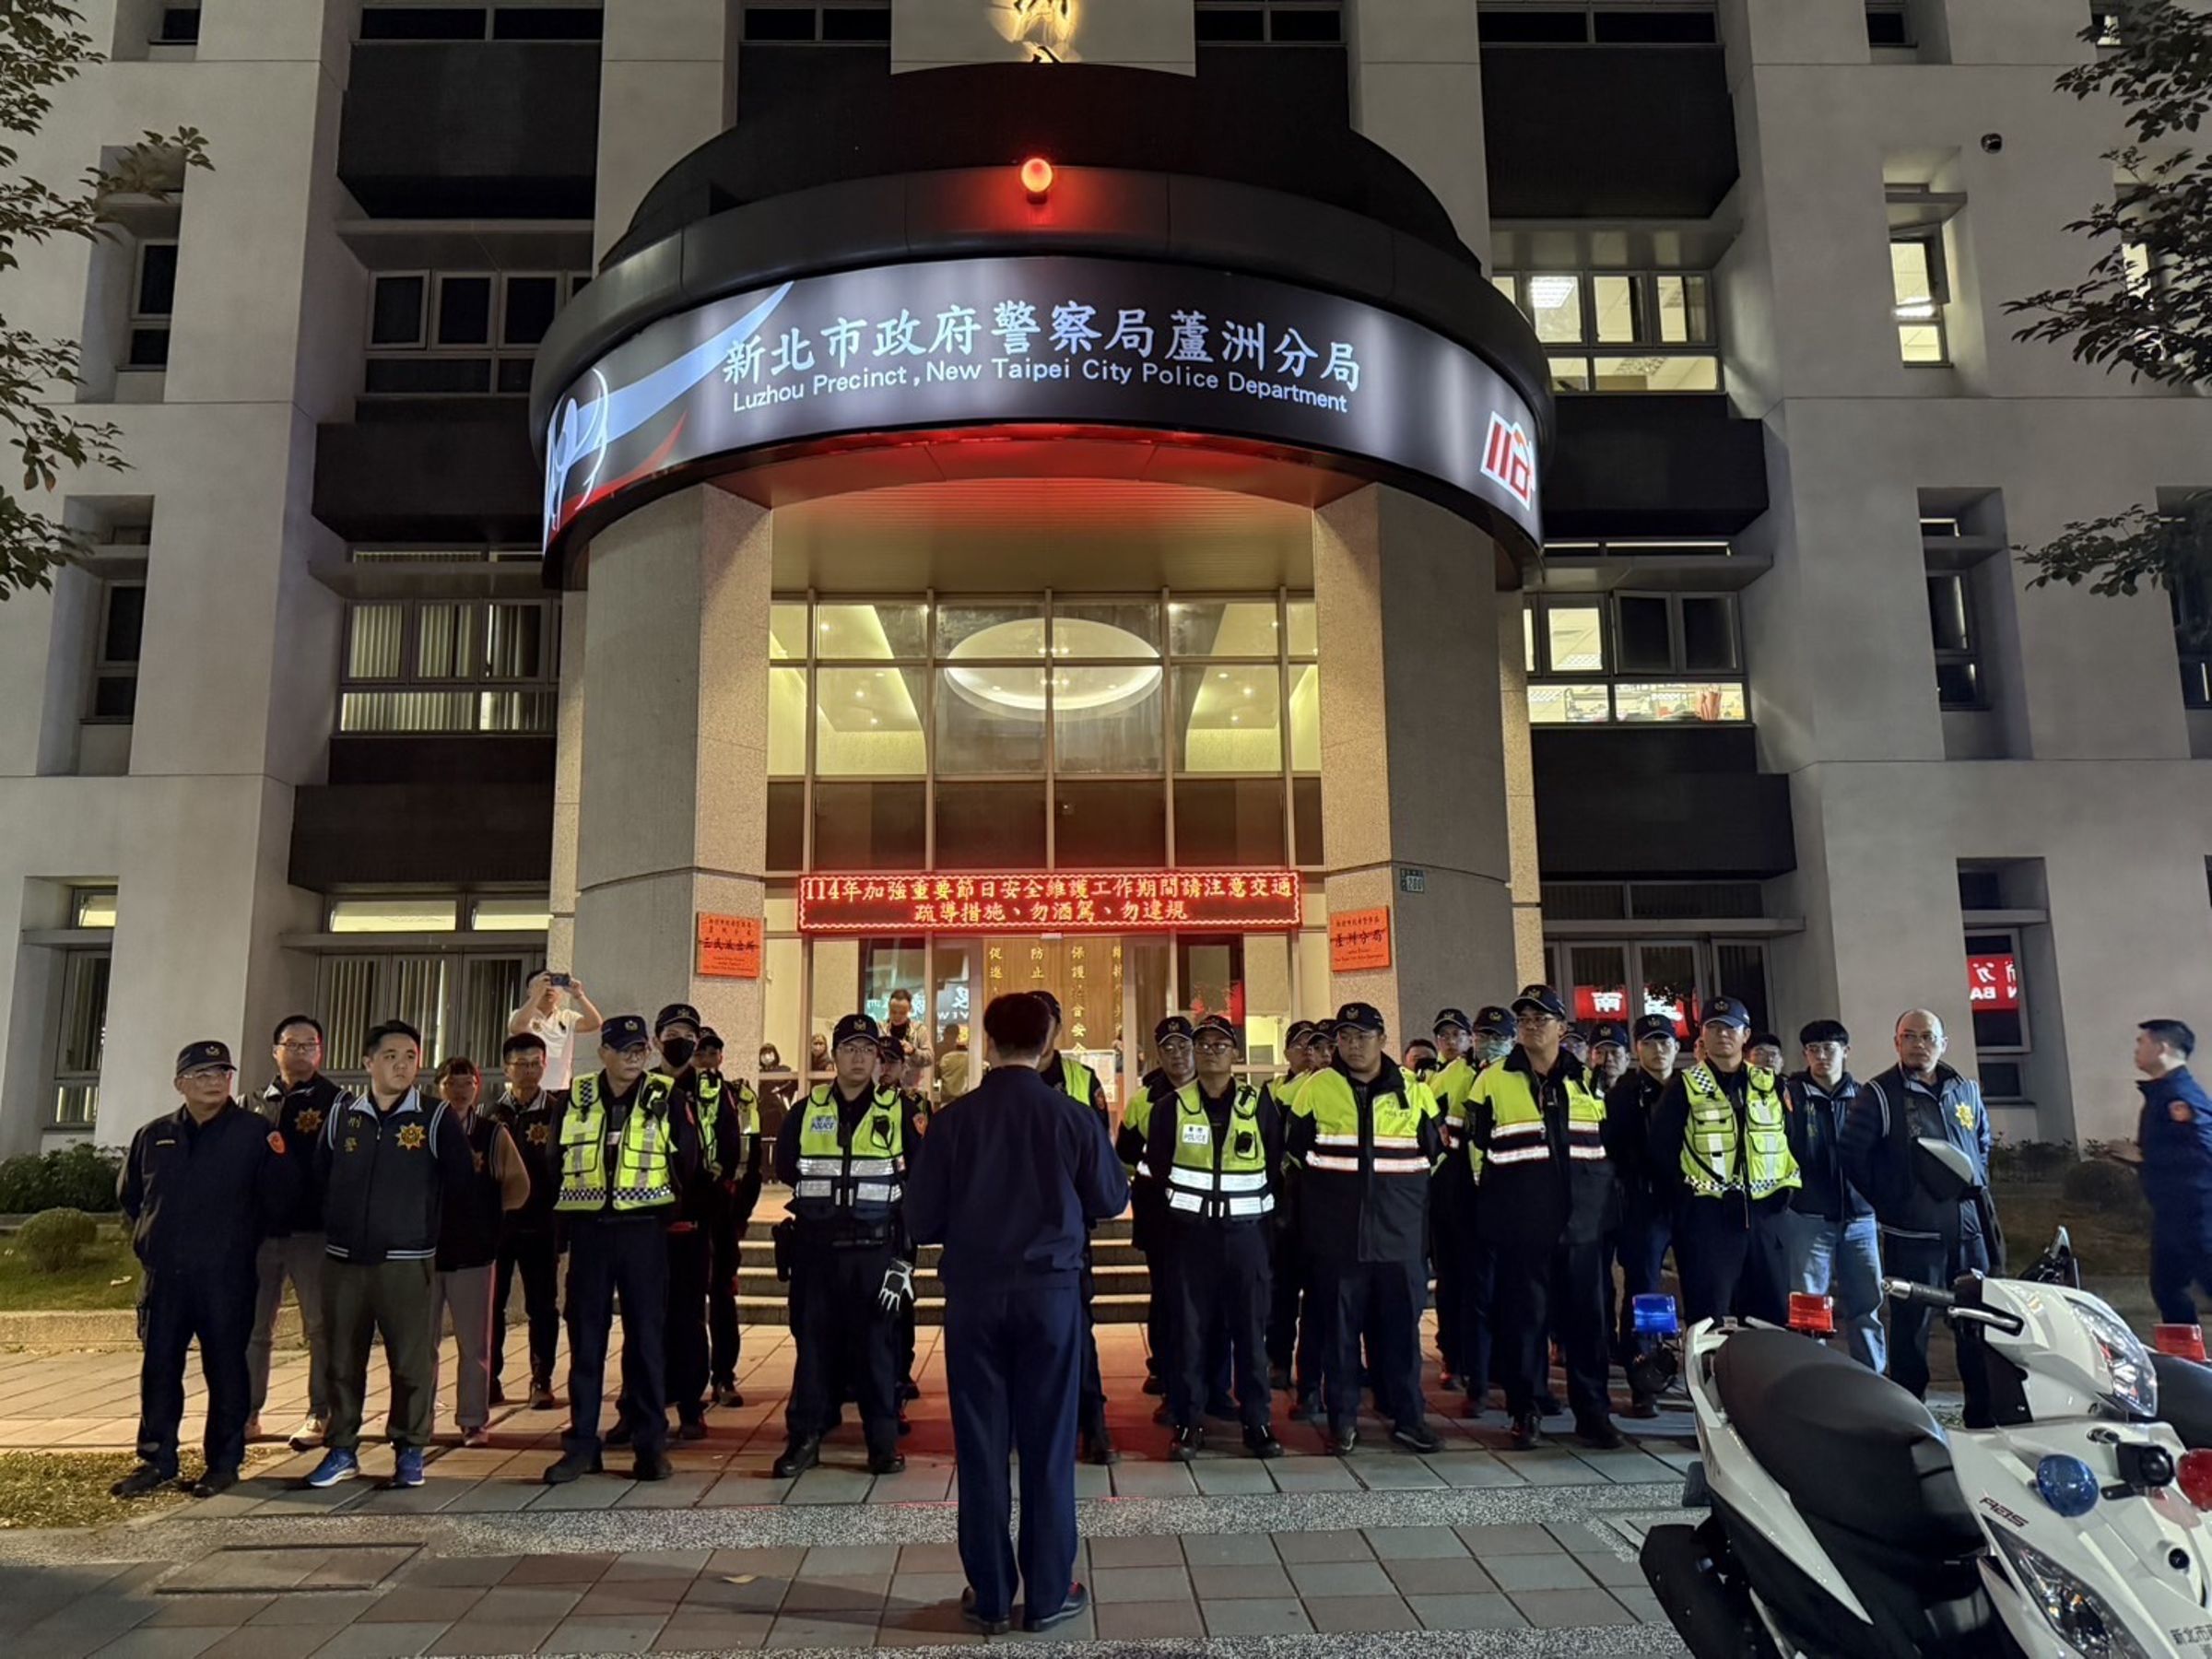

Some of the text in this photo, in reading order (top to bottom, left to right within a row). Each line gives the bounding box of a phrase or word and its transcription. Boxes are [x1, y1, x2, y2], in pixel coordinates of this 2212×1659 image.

[723, 299, 1361, 393] 新北市政府警察局蘆洲分局
[733, 382, 805, 413] Luzhou
[926, 359, 982, 382] New
[992, 357, 1070, 382] Taipei
[1082, 359, 1133, 387] City
[1143, 363, 1219, 390] Police
[1230, 371, 1348, 414] Department
[806, 877, 1293, 901] 114年加強重要節日安全維護工作期間請注意交通
[914, 900, 1188, 924] 疏導措施、勿酒駕、勿違規
[989, 947, 1003, 994] 促進
[1030, 948, 1045, 979] 防止
[2170, 1624, 2212, 1645] 新北市
